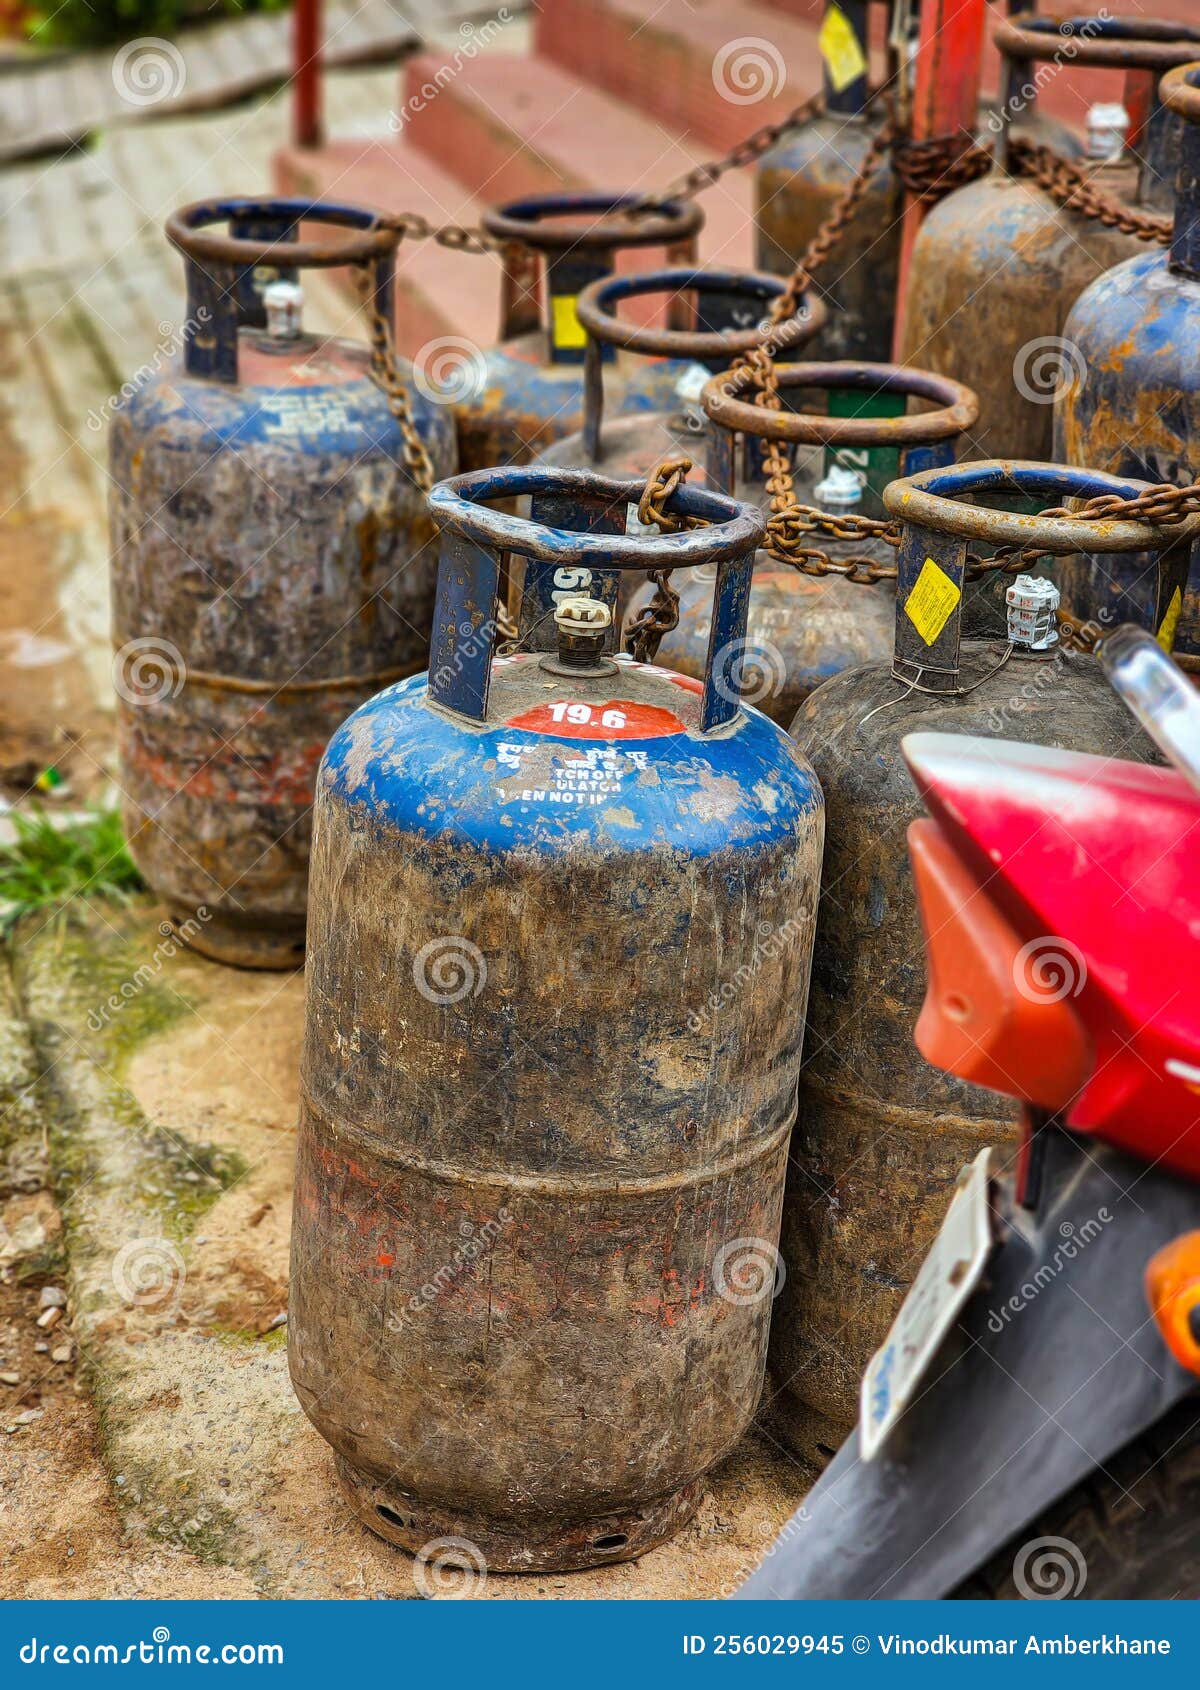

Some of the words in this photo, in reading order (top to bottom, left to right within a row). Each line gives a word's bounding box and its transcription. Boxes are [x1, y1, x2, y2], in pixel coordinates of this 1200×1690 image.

[548, 702, 627, 729] 19.6
[555, 768, 590, 780] TCH
[591, 769, 625, 781] OFF
[549, 791, 586, 804] NOT
